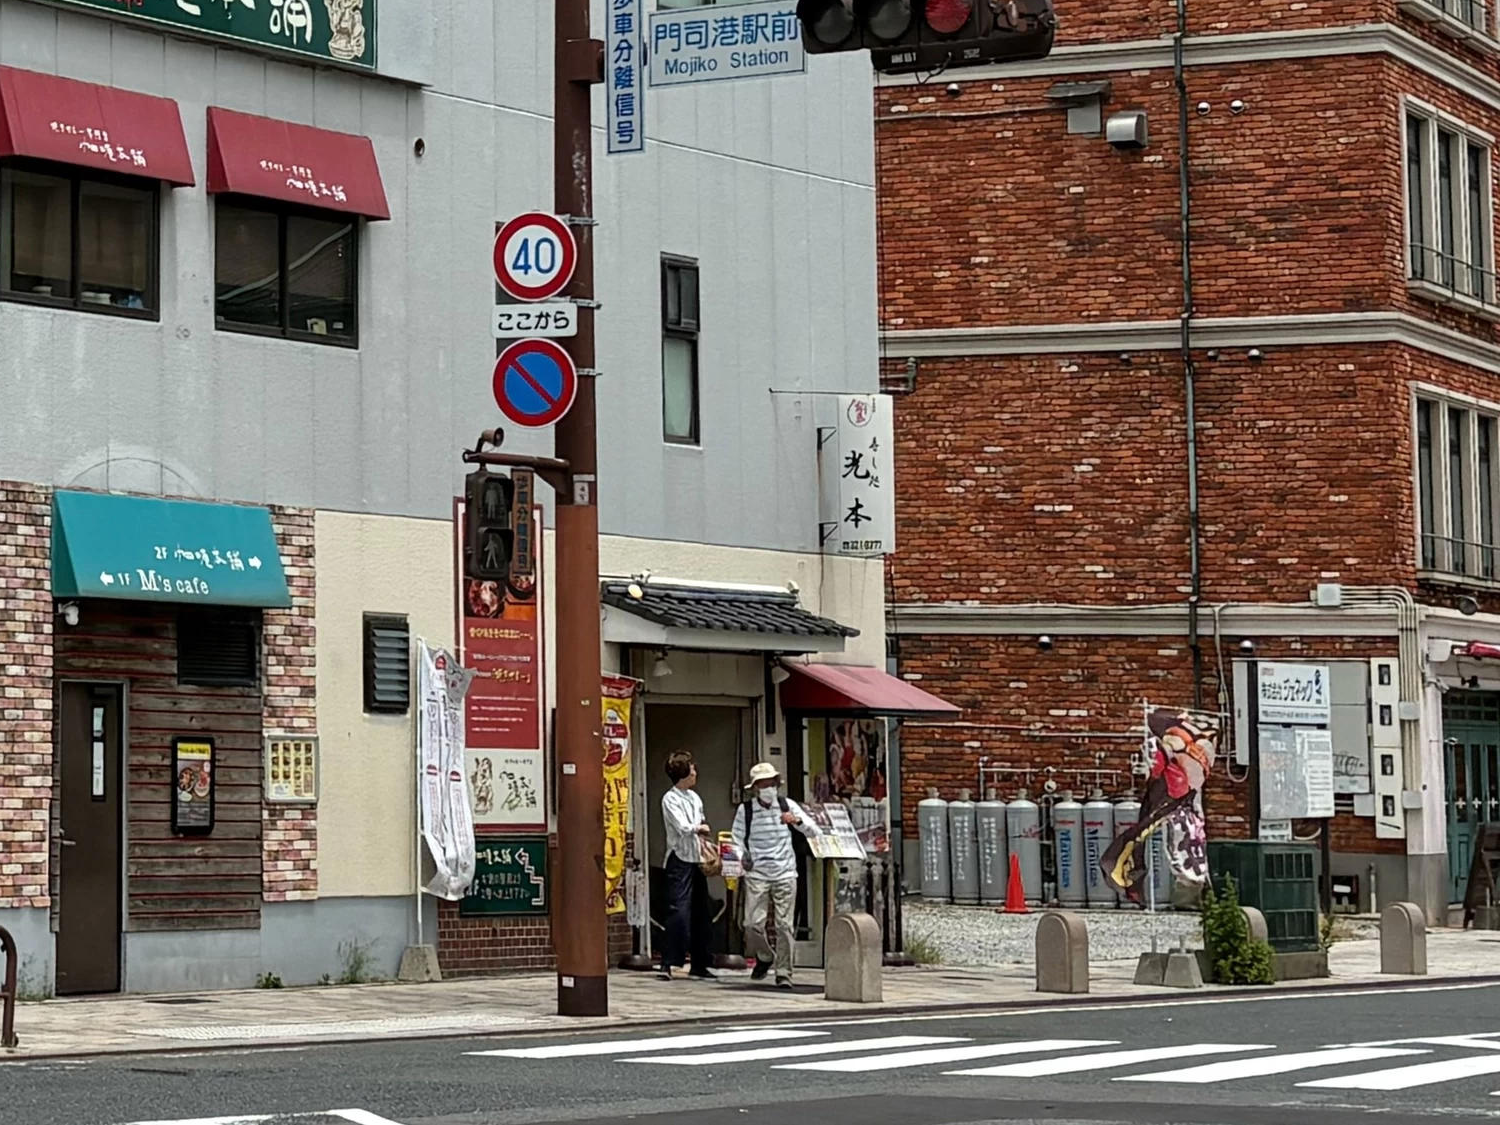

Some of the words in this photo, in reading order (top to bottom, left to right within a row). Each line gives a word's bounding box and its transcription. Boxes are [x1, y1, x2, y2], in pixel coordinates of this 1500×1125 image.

[654, 10, 800, 55] 門司港駅前
[664, 56, 718, 77] Mojiko
[730, 48, 789, 69] Station
[512, 237, 556, 275] 40
[498, 311, 570, 331] ここから
[842, 450, 872, 528] 光本
[154, 546, 168, 559] 2F
[117, 573, 131, 585] 1F
[136, 569, 172, 592] M's
[176, 577, 209, 595] cafe
